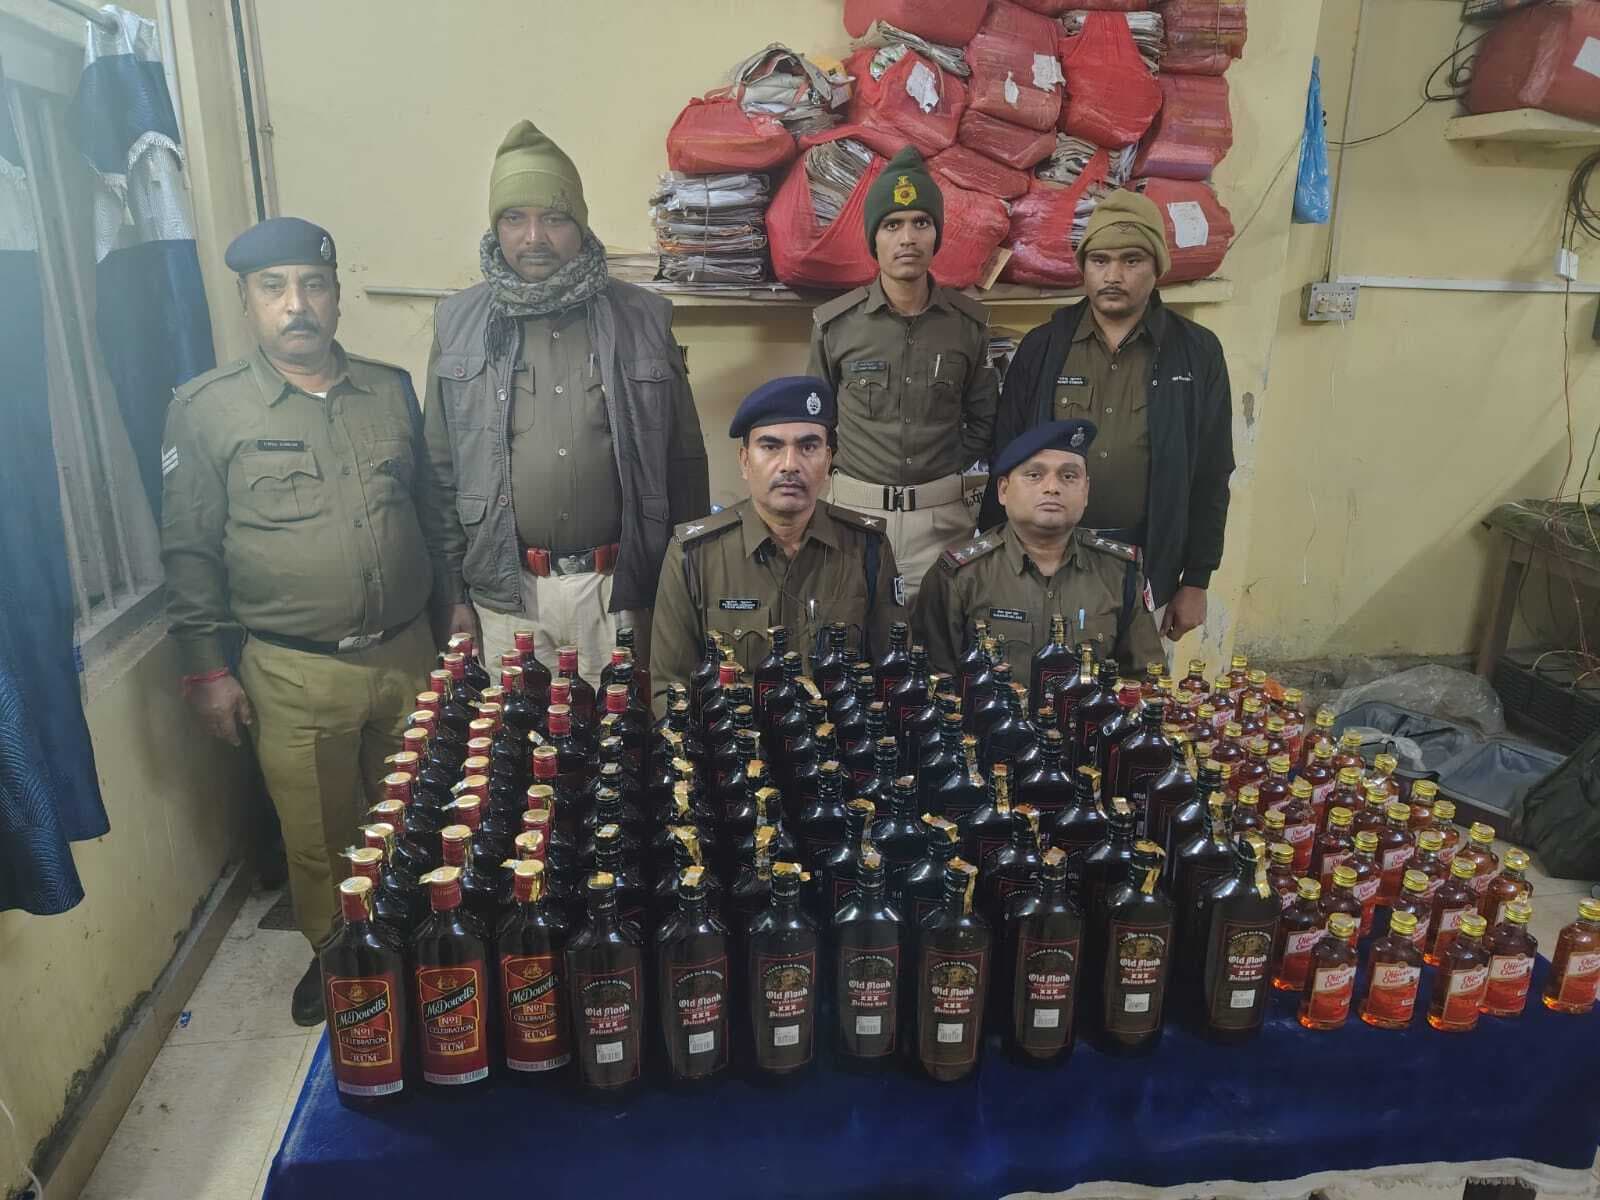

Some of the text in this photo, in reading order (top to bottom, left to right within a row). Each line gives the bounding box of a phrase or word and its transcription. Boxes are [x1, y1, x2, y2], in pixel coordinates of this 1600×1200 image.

[1120, 958, 1161, 968] Old Monk
[1228, 954, 1267, 965] Old Monk
[1028, 974, 1070, 984] Old Monk
[512, 975, 559, 1004] McDowell's
[848, 980, 891, 990] Old Monk
[766, 987, 808, 999] Old Monk
[931, 986, 974, 997] Old Monk
[427, 985, 475, 1018] McDowell's
[679, 999, 695, 1008] Old
[697, 993, 721, 1007] Monk
[339, 998, 387, 1027] McDowell's
[585, 1003, 629, 1016] Old Monk
[429, 1023, 474, 1034] CELEBRATION
[525, 1029, 548, 1038] RUM
[440, 1041, 465, 1051] RUM
[353, 1054, 377, 1063] RUM
